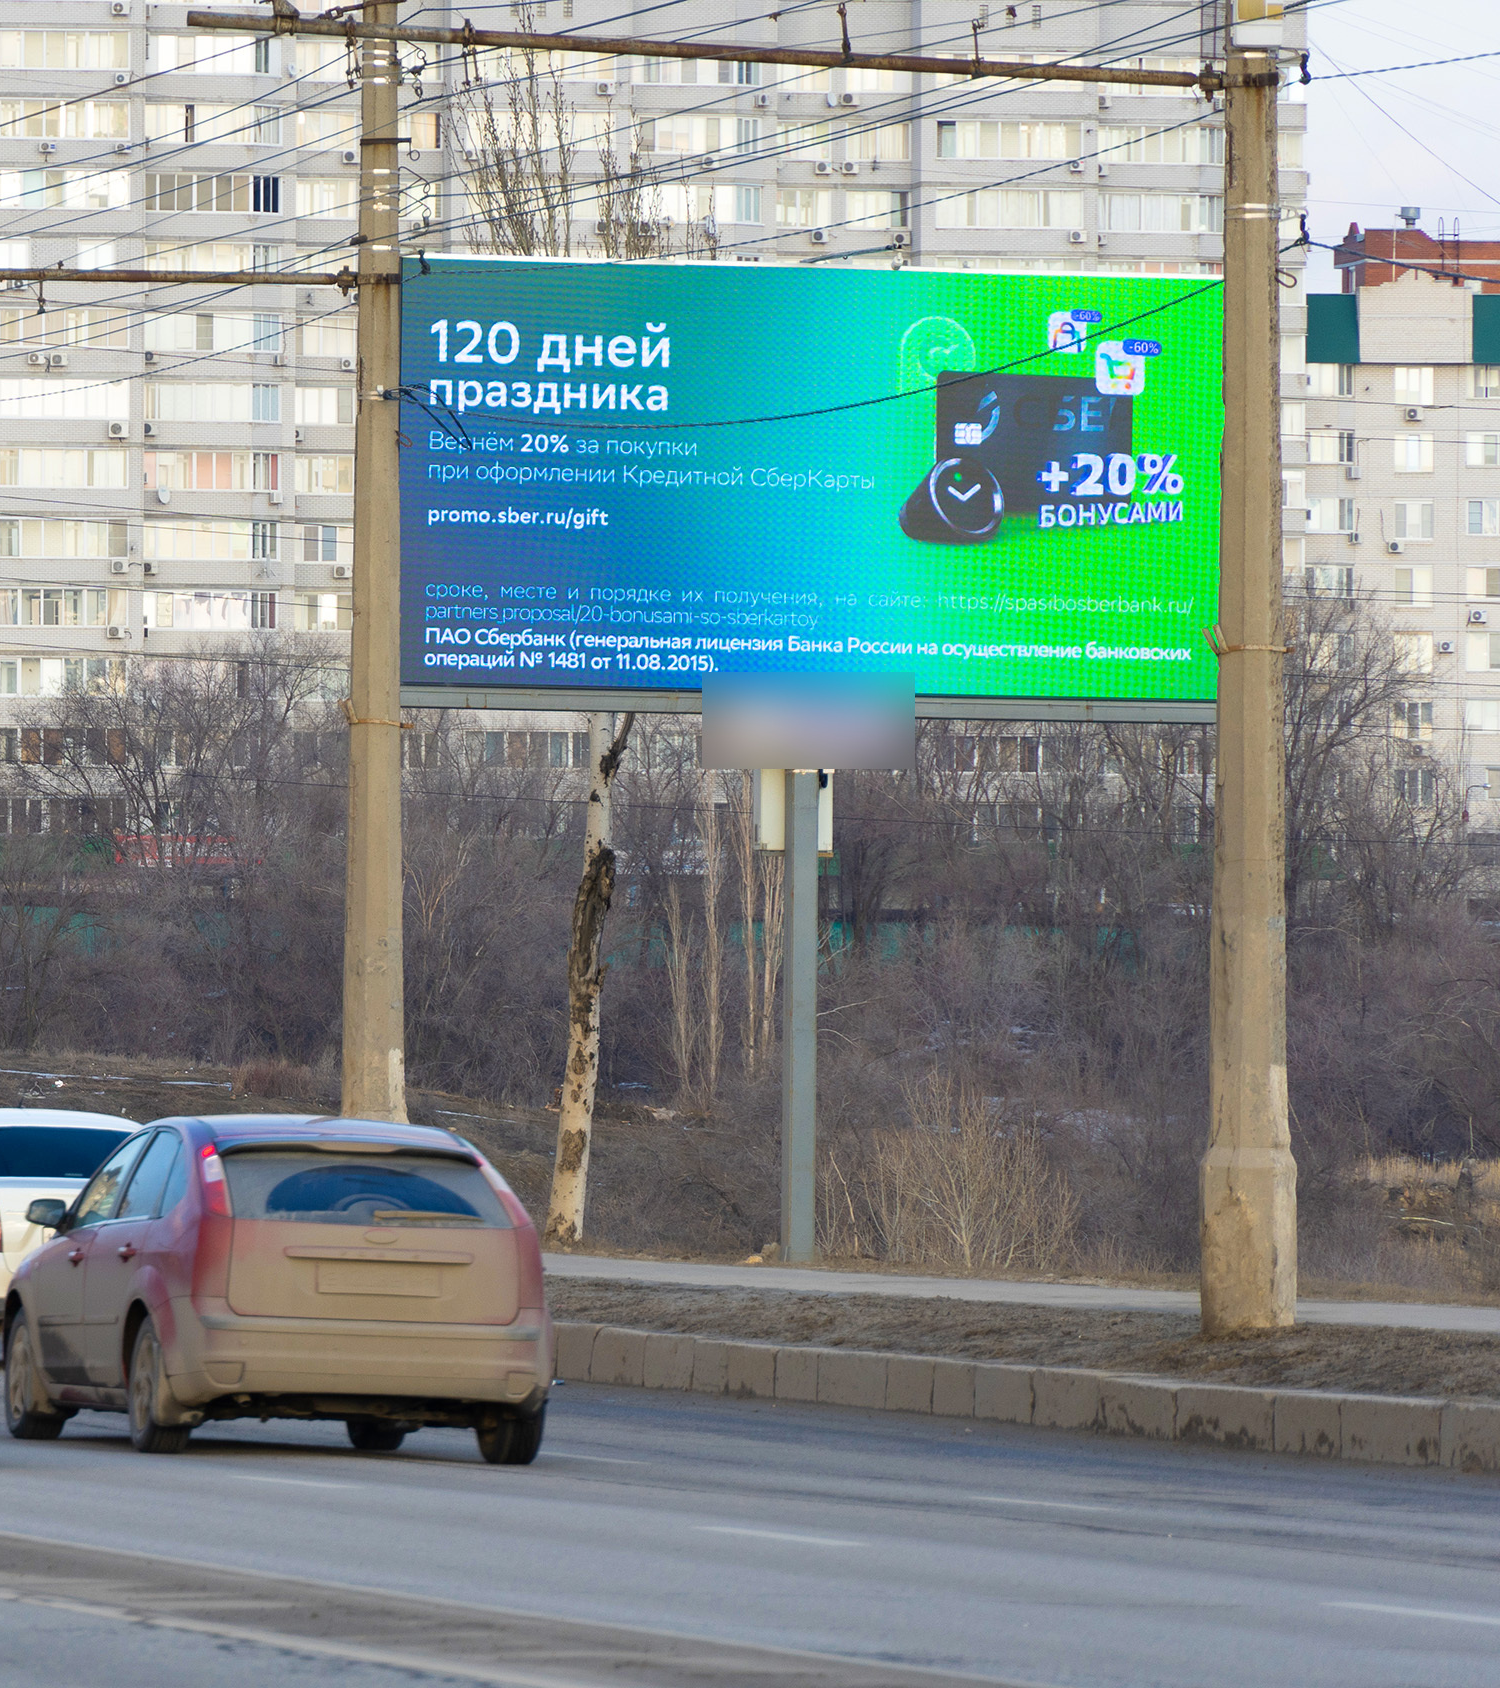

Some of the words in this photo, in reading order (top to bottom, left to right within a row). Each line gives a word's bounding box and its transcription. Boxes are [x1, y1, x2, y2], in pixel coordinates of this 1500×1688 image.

[429, 319, 521, 365] 120
[537, 321, 671, 373] дней
[1129, 341, 1159, 355] -60%
[429, 377, 669, 415] праздника
[429, 430, 514, 454] Вернём
[520, 433, 569, 453] 20%
[576, 438, 600, 453] за
[606, 438, 698, 458] покупки
[428, 464, 469, 484] при
[476, 461, 616, 485] оформлении
[622, 464, 744, 487] Кредитной
[750, 467, 875, 492] СберКарты
[1037, 453, 1184, 497] +20%
[428, 507, 609, 530] promo.sber.ru/gift
[1039, 501, 1184, 529] БОНУСАМИ
[425, 583, 489, 600] сроке,
[500, 585, 557, 599] месте
[568, 586, 580, 599] и
[591, 587, 671, 604] порядке
[682, 588, 703, 602] их
[715, 590, 823, 607] получения,
[835, 594, 857, 606] на
[868, 592, 926, 608] сайте:
[938, 592, 1194, 616] https://spasibosberbank.ru/
[425, 628, 472, 645] ПАО
[475, 628, 566, 648] Сбербанк
[569, 630, 692, 651] (генеральная
[695, 636, 783, 653] лицензия
[788, 635, 843, 653] Банка
[847, 637, 913, 655] России
[916, 641, 938, 655] на
[942, 642, 1082, 660] осуществление
[1085, 640, 1192, 661] банковских
[424, 651, 515, 670] операций
[520, 652, 544, 668] №
[548, 652, 586, 669] 1481
[591, 655, 612, 669] от
[616, 653, 719, 672] 11.08.2015).
